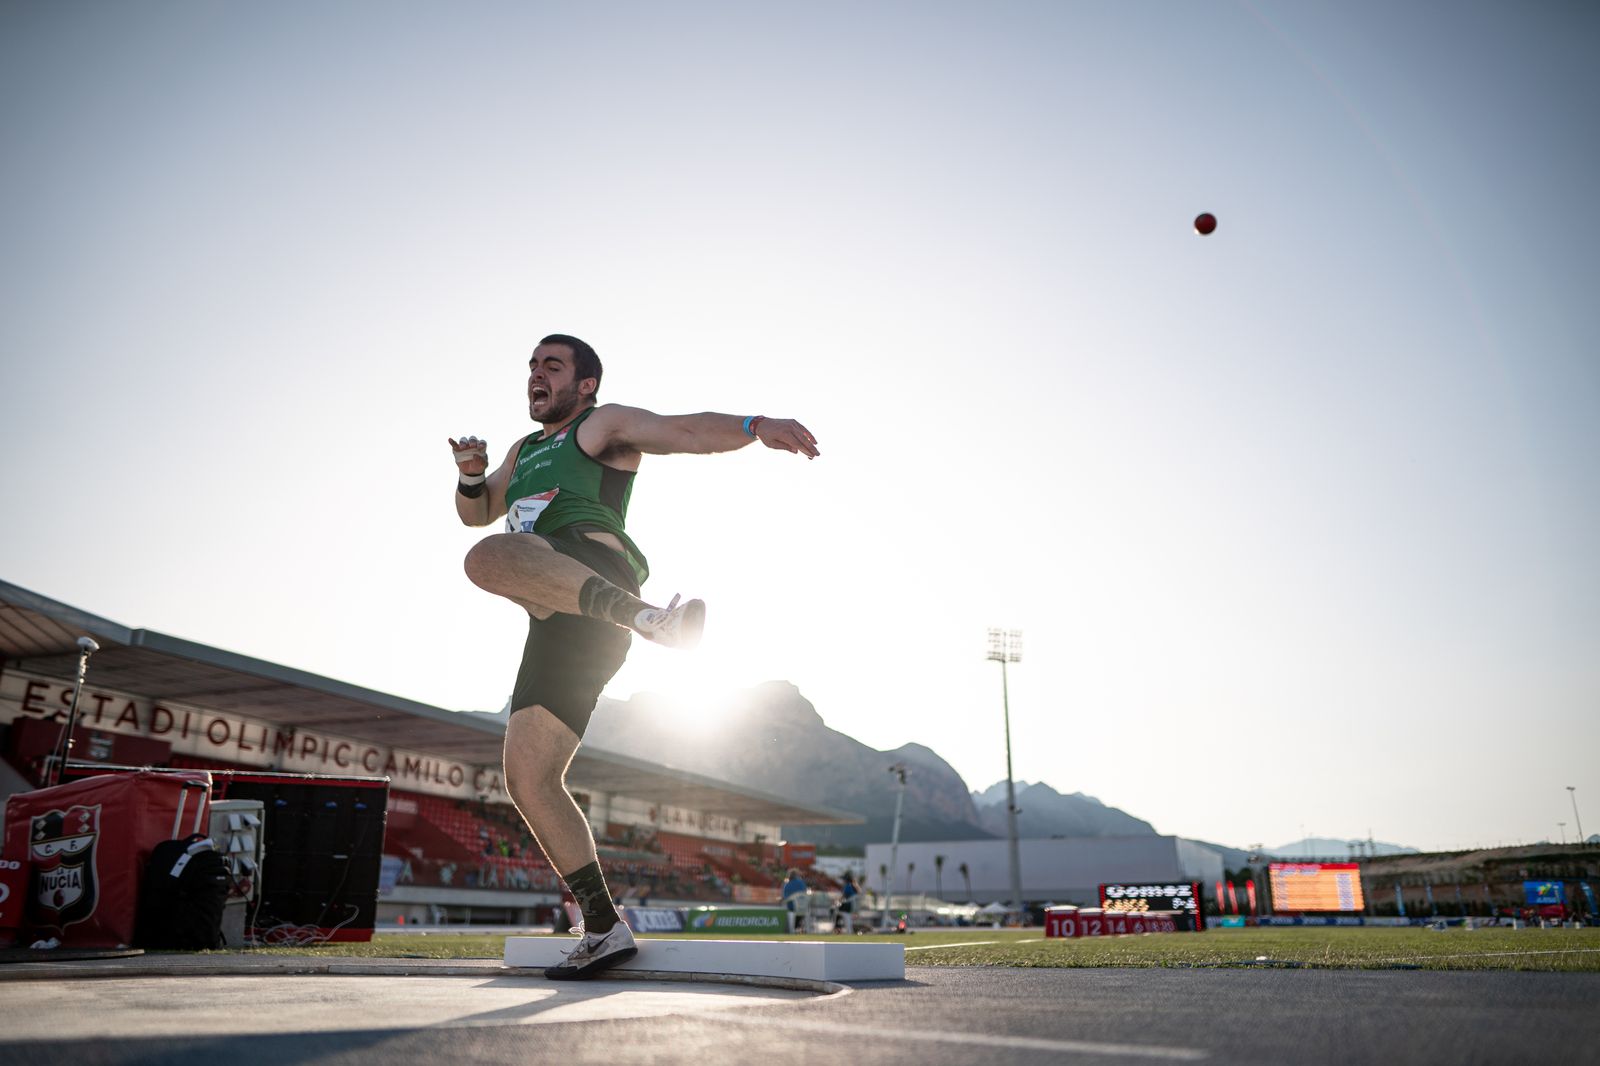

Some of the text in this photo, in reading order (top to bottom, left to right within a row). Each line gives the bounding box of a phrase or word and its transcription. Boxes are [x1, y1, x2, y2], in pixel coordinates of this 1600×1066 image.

[22, 681, 190, 738] ESTADI
[206, 719, 351, 768] OLIMPIC
[361, 748, 465, 787] CAMILO
[716, 916, 780, 928] IBERDROLA
[1051, 919, 1076, 938] 10
[1080, 920, 1102, 936] 12
[1107, 920, 1126, 935] 14
